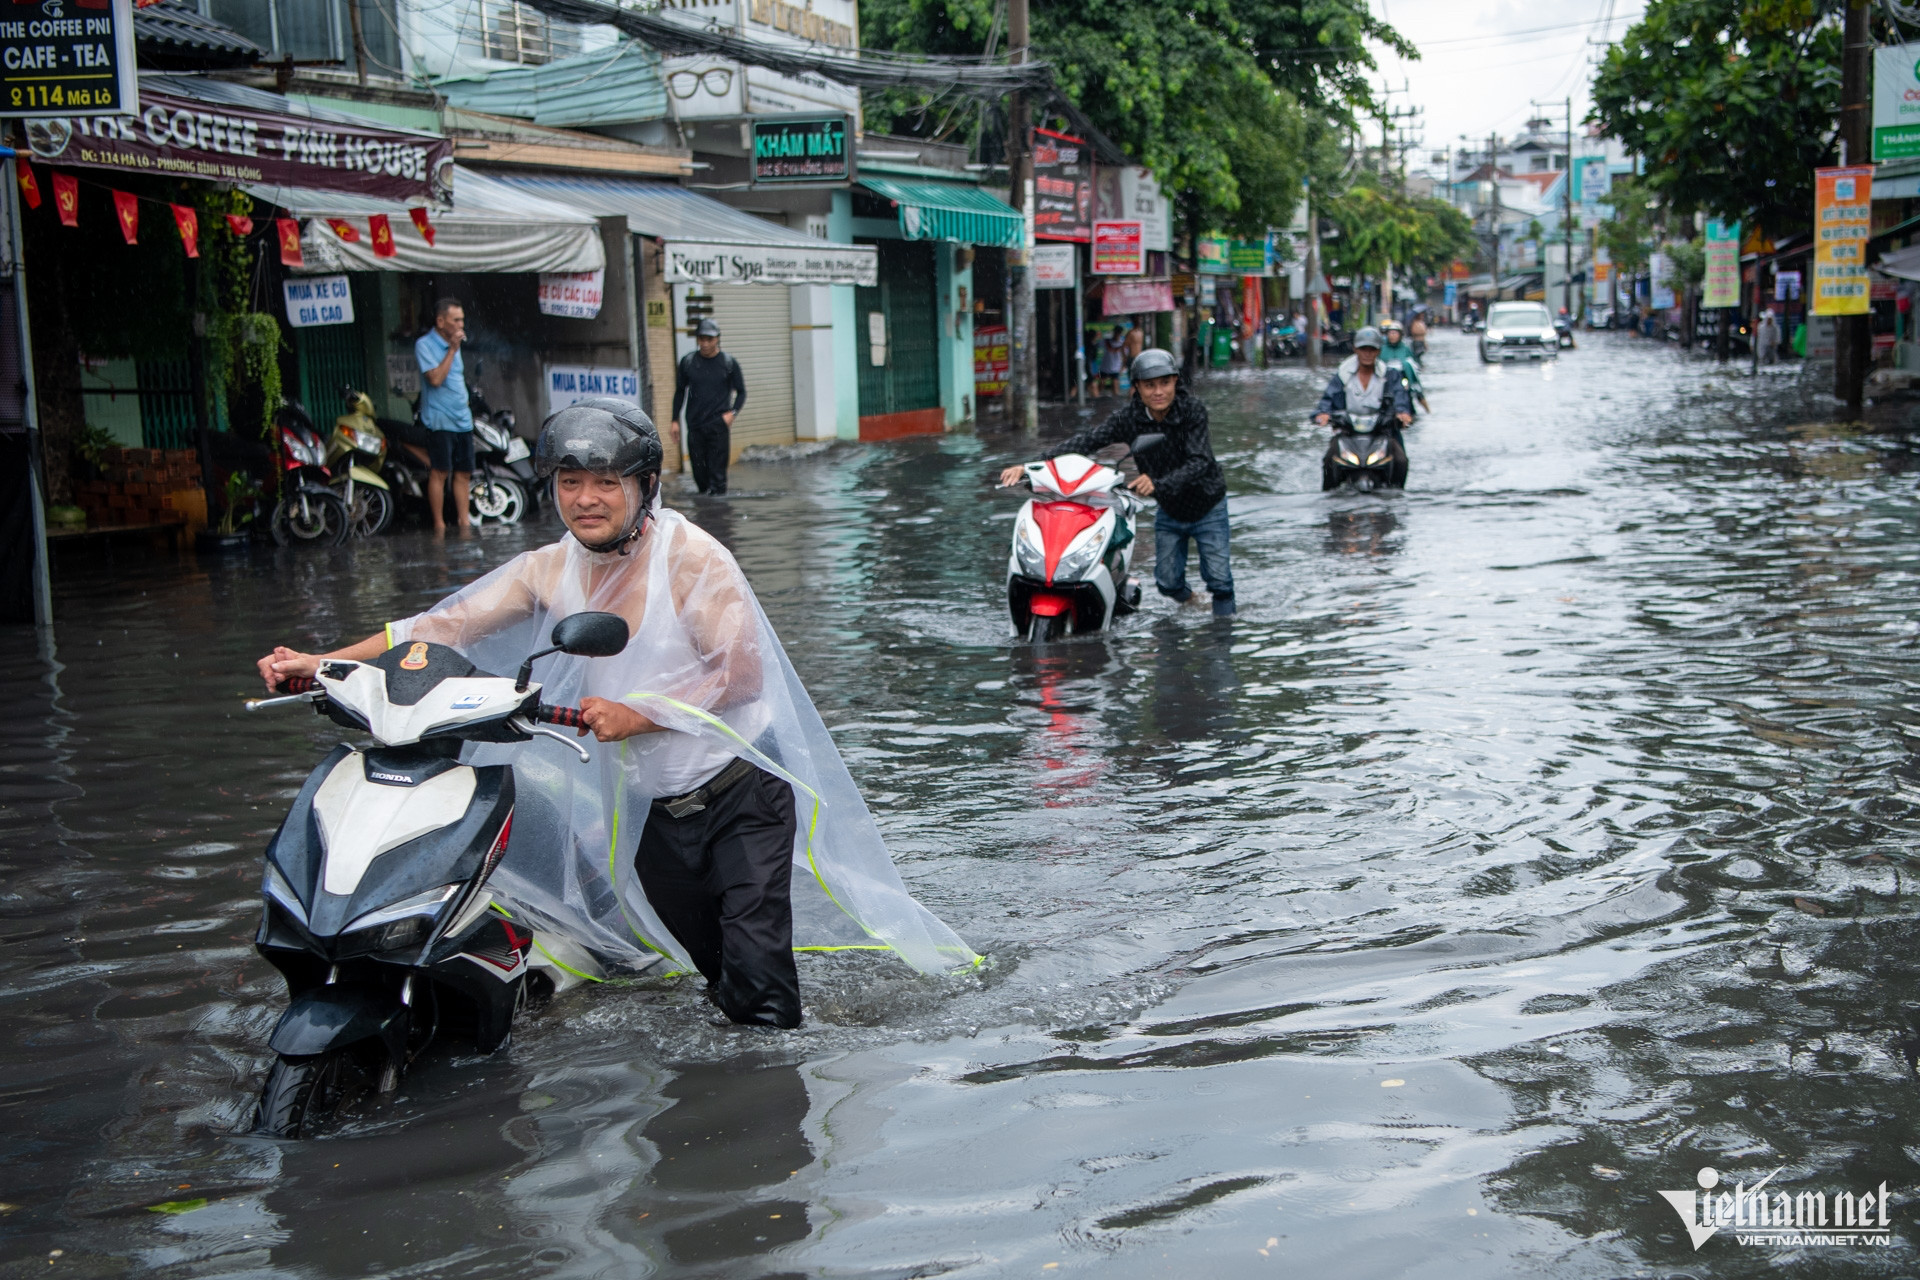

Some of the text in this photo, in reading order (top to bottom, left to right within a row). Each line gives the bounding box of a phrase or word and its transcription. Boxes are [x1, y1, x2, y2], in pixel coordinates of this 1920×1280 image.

[0, 17, 111, 38] THE COFFEE PNI
[4, 45, 57, 70] CAFE
[72, 43, 110, 68] TEA
[26, 85, 112, 106] 114 Mã Lò
[144, 106, 258, 157] COFFEE
[345, 135, 427, 181] HOUSE
[755, 122, 844, 157] KHÁM MẮT
[100, 151, 119, 164] 114
[672, 253, 763, 281] FourT Spa
[287, 280, 347, 301] MUA XE CŨ
[299, 304, 343, 323] GIÁ CAO
[552, 371, 637, 395] MUA BÁN XE CŨ
[371, 772, 413, 782] HONDA
